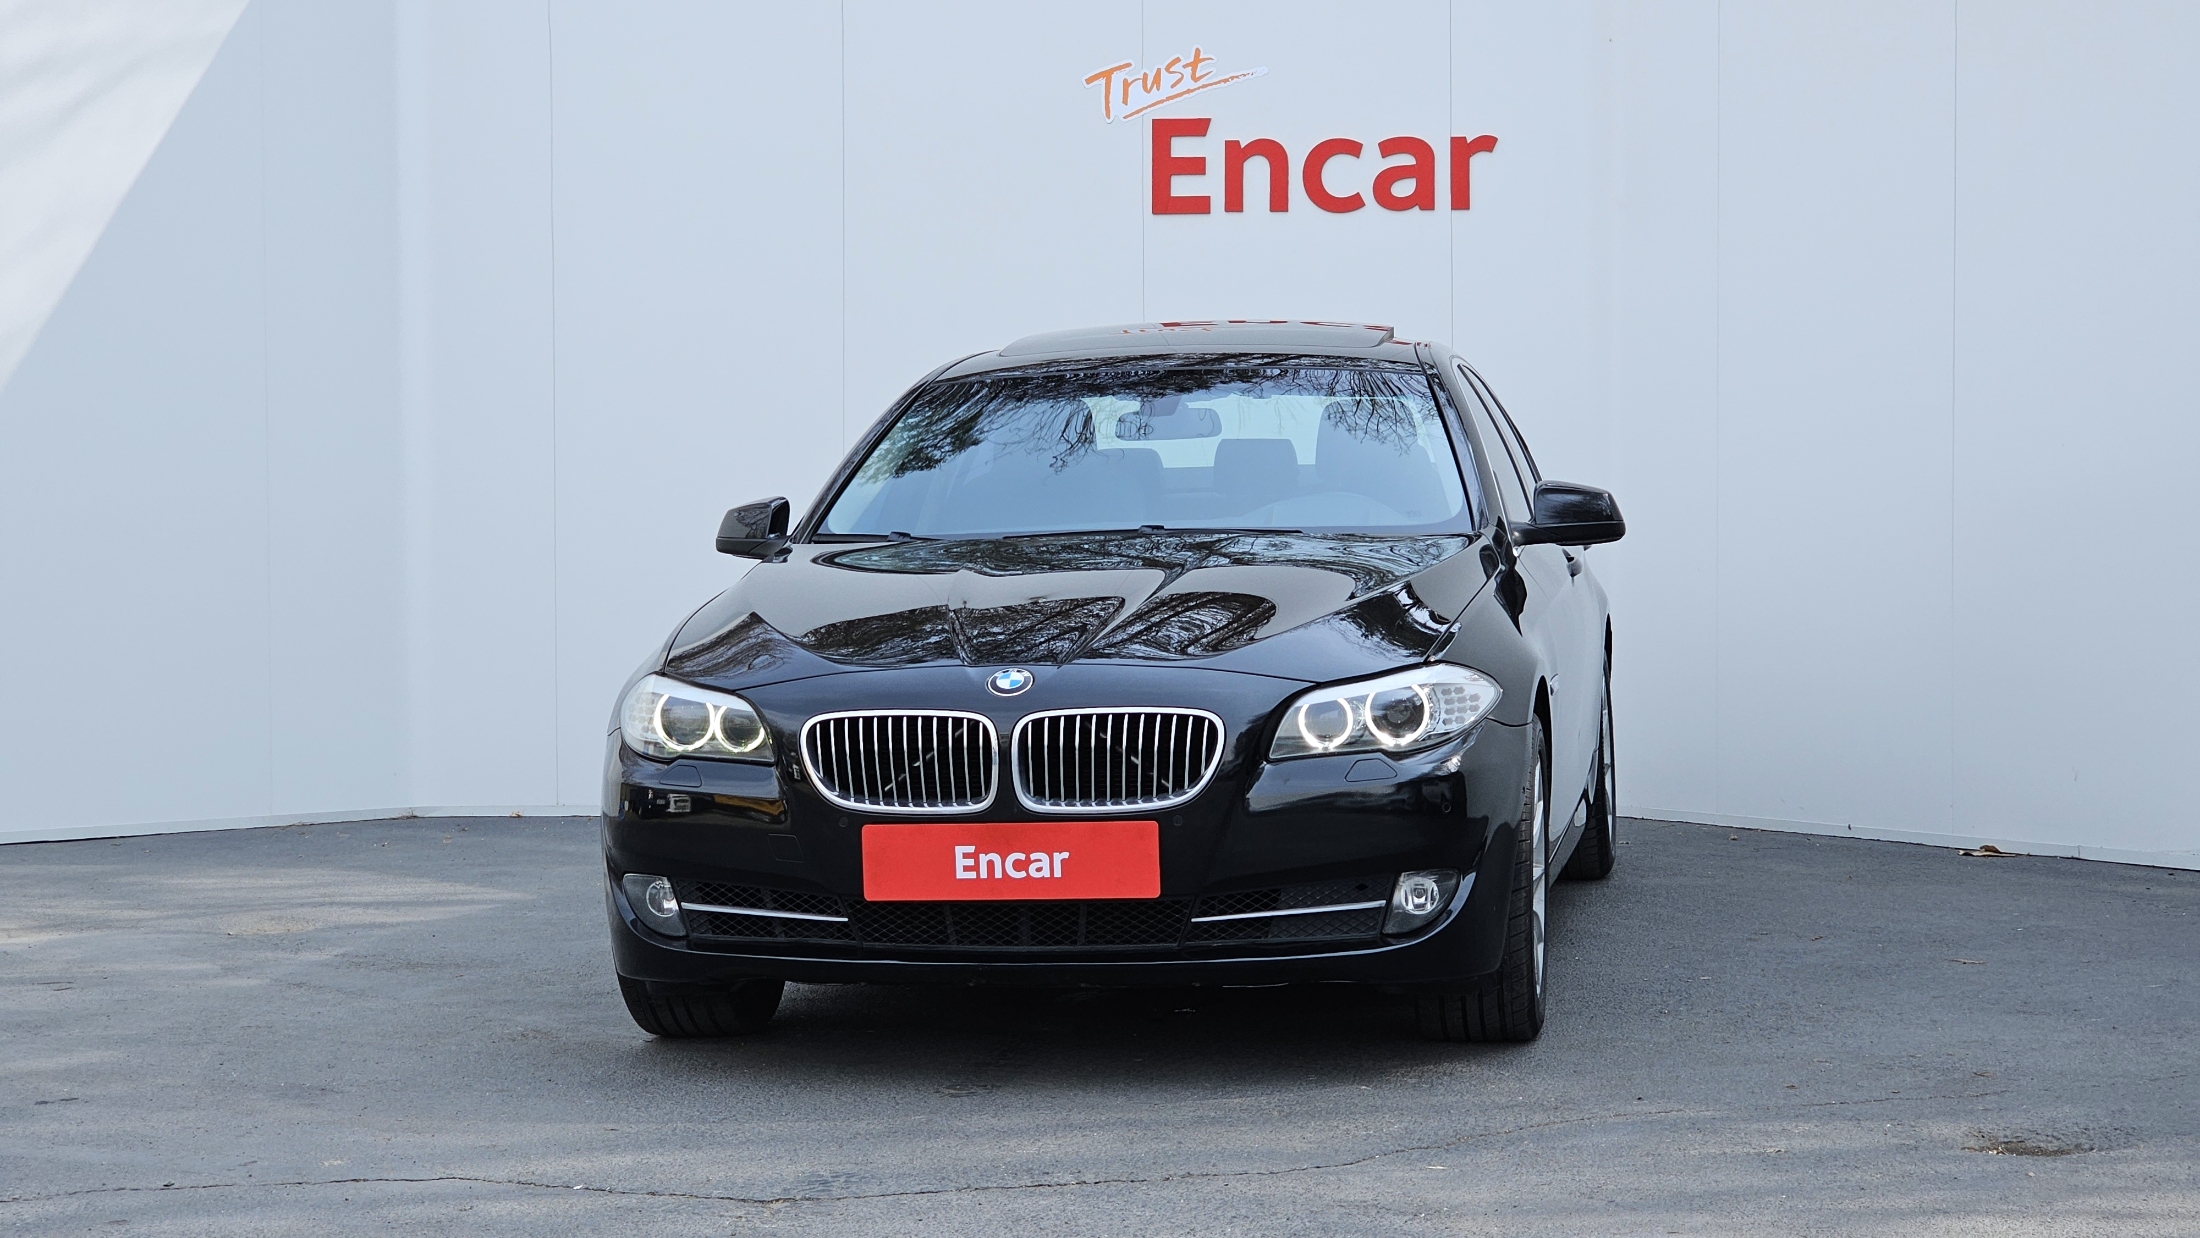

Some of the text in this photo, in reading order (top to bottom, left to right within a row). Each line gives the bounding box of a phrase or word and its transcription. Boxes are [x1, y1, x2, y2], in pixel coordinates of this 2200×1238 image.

[1085, 47, 1215, 120] Trust
[1151, 118, 1498, 215] Encar
[954, 845, 1070, 879] Encar
